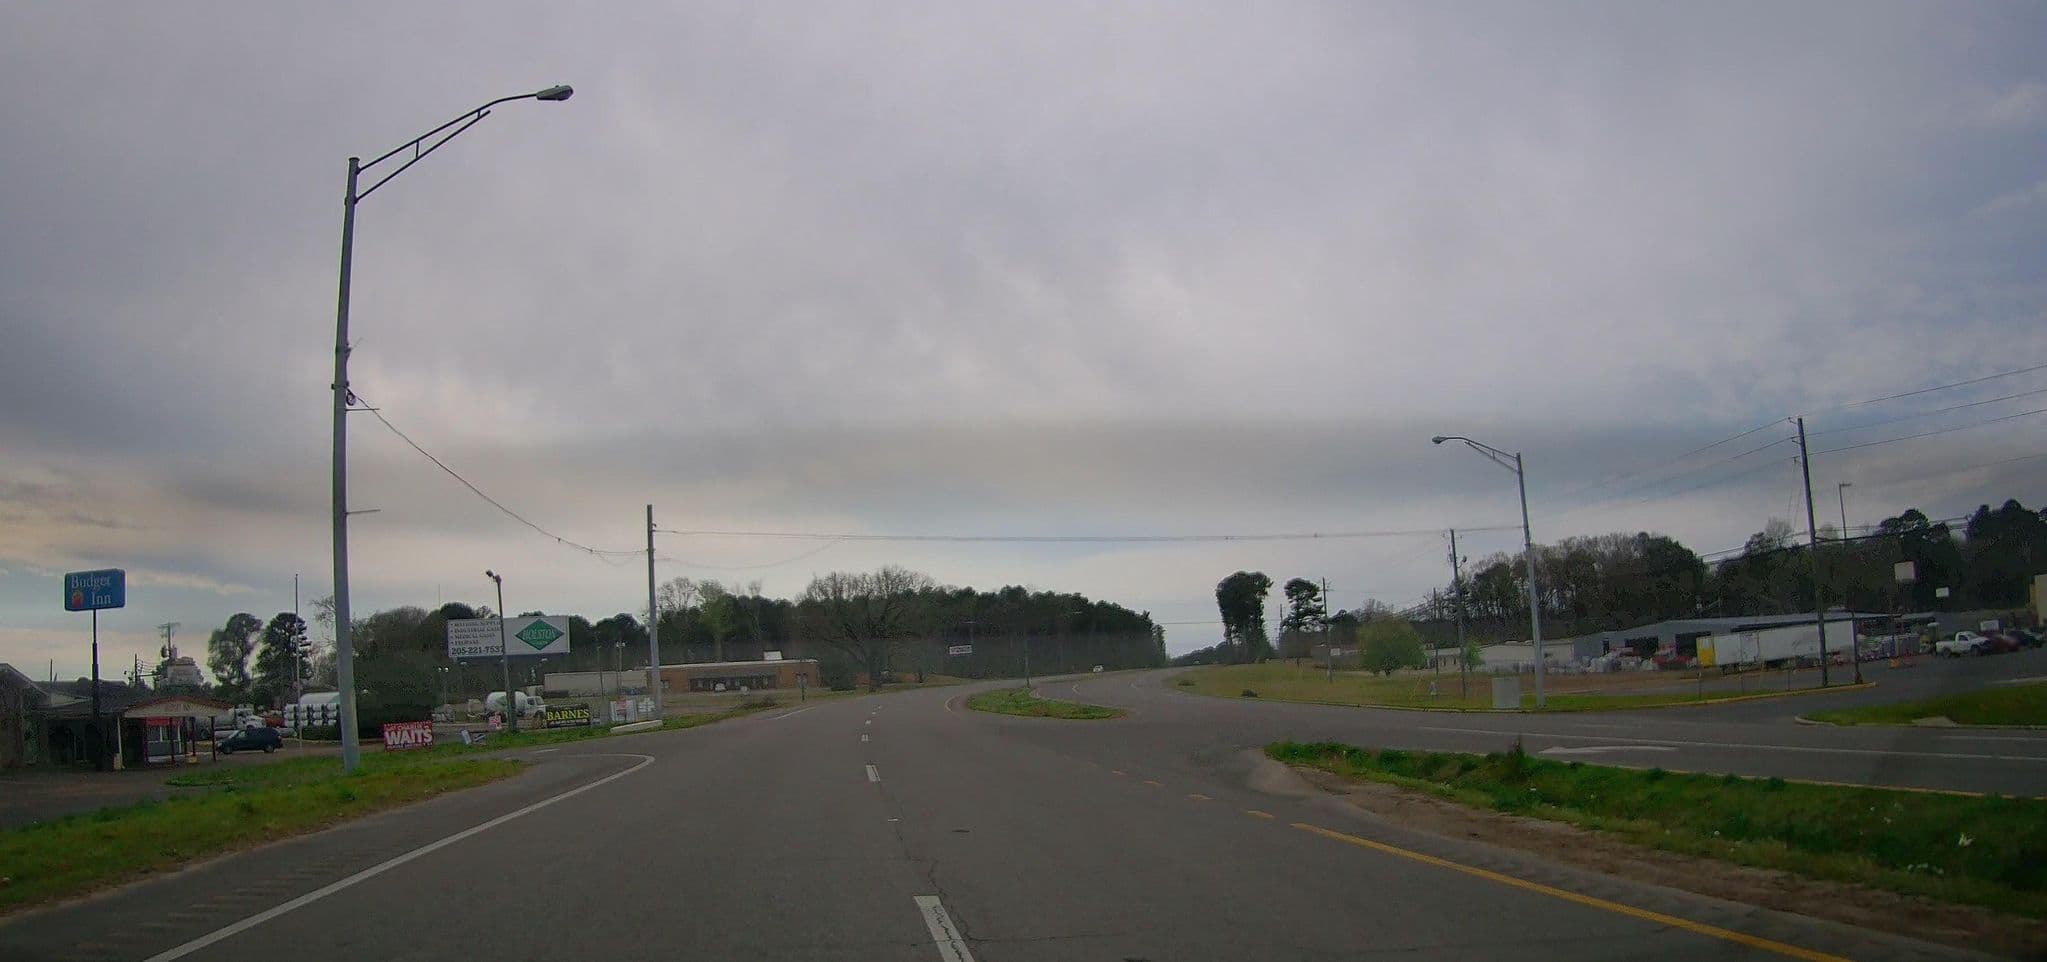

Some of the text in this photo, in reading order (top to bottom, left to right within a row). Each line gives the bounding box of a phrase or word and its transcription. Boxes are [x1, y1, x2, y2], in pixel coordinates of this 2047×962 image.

[71, 573, 111, 590] Budget
[91, 591, 112, 605] Inn
[547, 709, 589, 721] BARNES
[384, 728, 433, 745] WAITS
